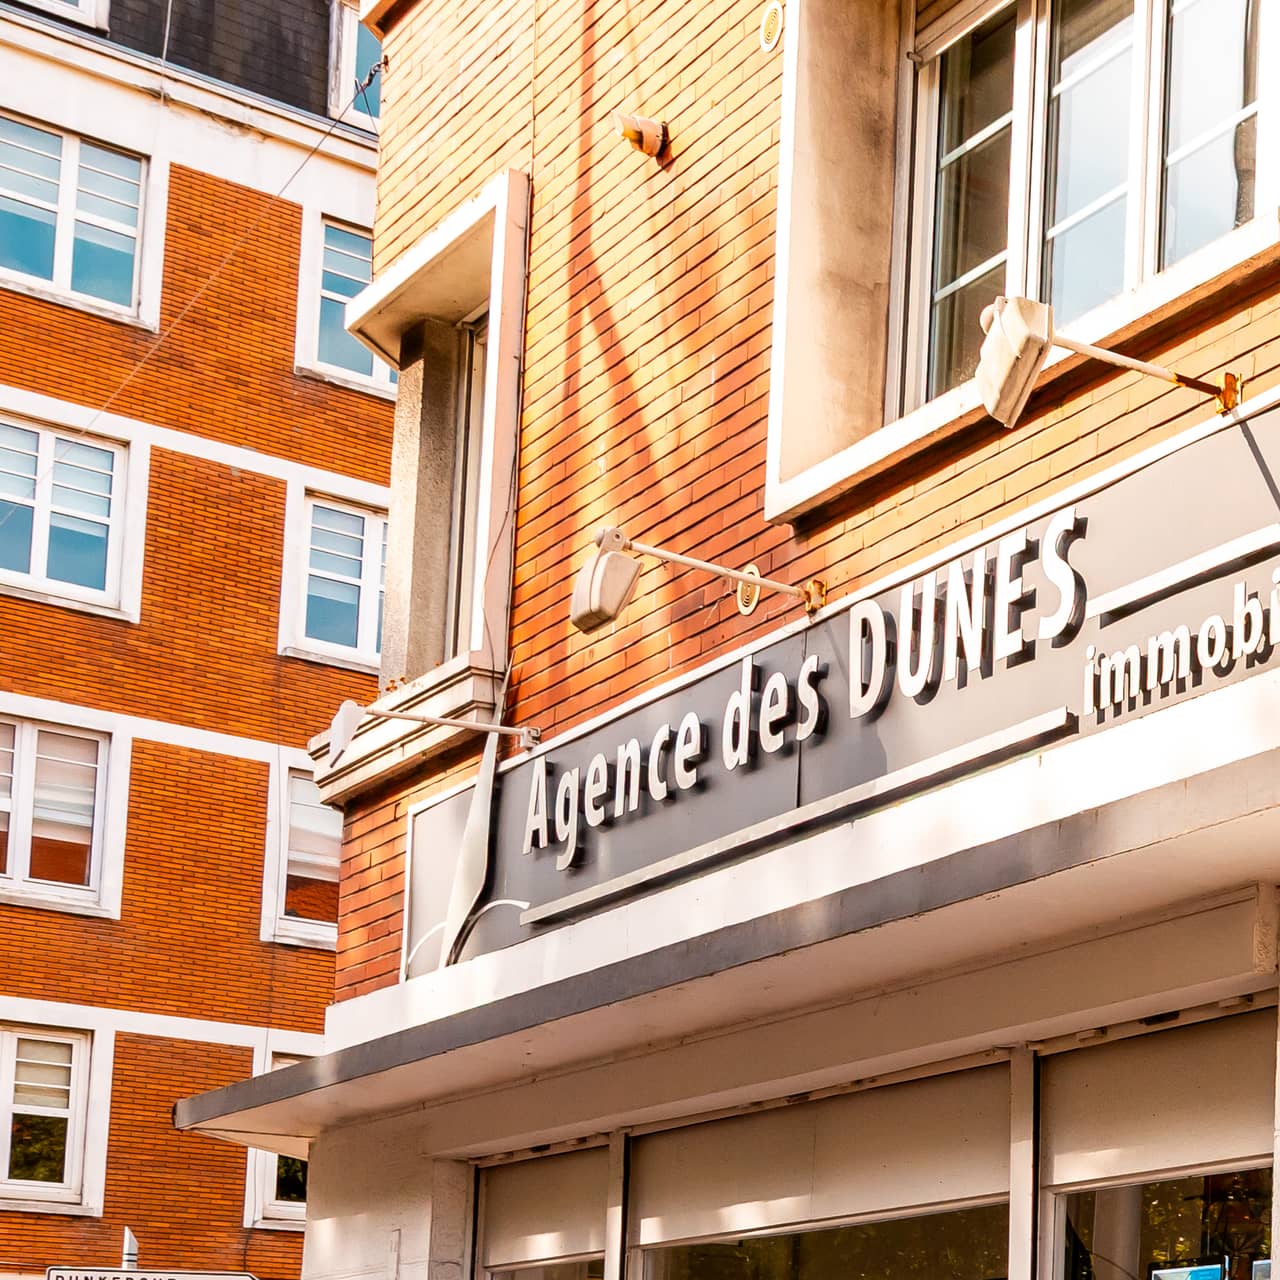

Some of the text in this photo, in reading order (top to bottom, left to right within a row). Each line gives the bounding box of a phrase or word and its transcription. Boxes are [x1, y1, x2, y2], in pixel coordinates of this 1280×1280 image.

[523, 507, 1078, 872] Agence des DUNES
